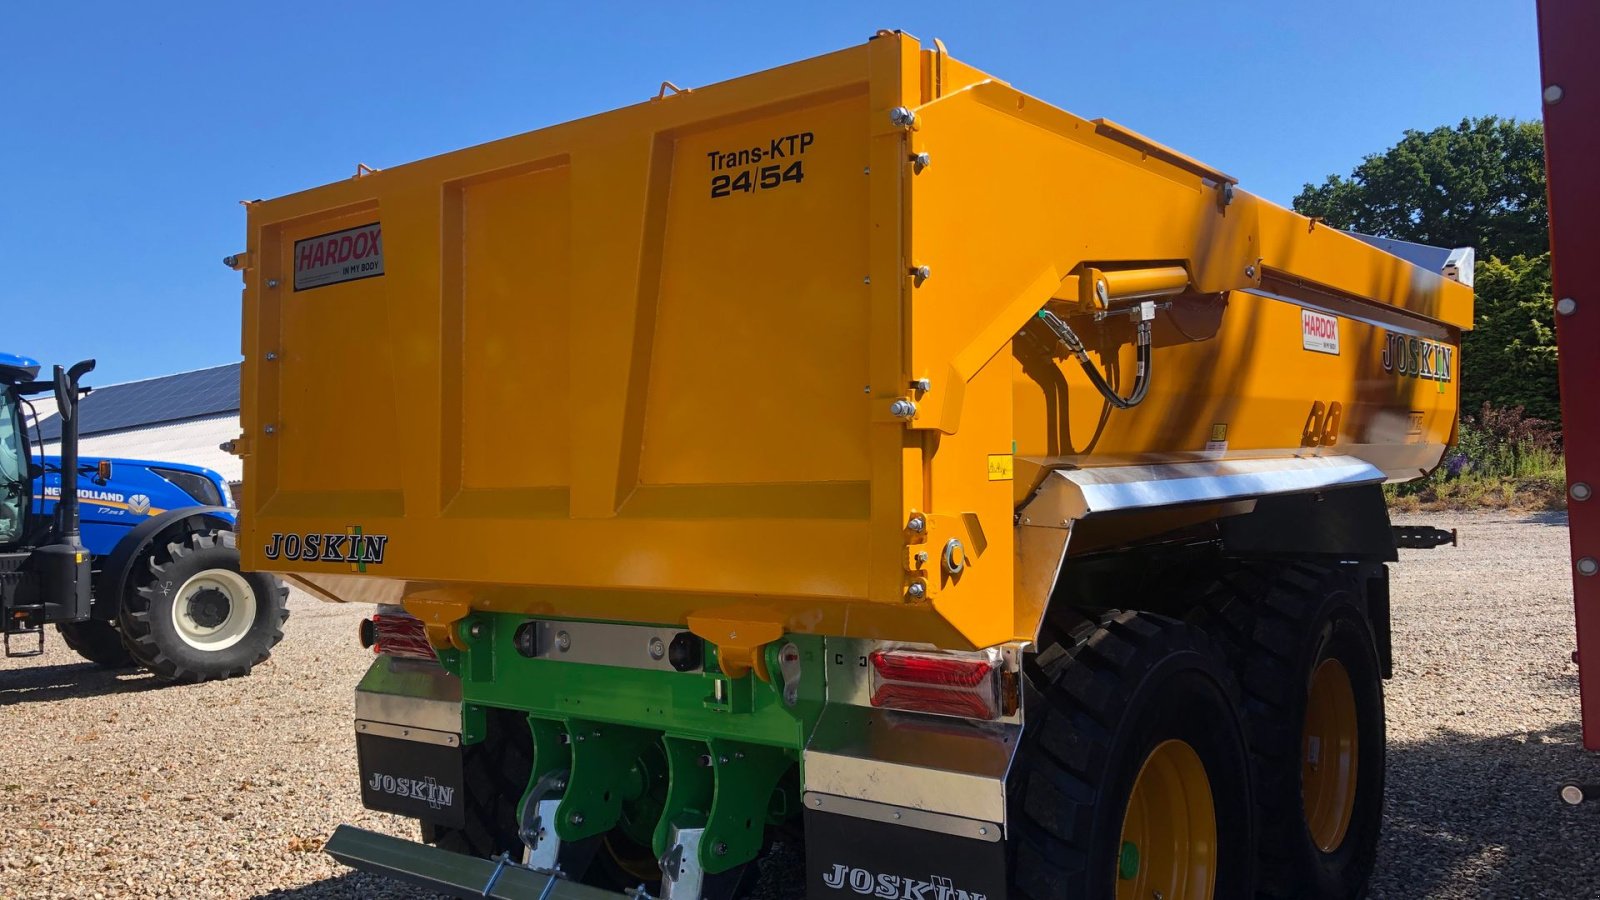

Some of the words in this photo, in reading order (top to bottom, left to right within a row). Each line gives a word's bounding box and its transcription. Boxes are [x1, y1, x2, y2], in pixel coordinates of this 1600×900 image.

[707, 132, 814, 171] Trans-KTP
[711, 160, 804, 199] 24/54
[299, 226, 381, 272] HARDOX
[342, 267, 350, 275] IN
[350, 264, 360, 274] MY
[361, 261, 379, 272] BODY
[1304, 313, 1336, 340] HARDOX
[1382, 332, 1452, 383] JOSKIN
[264, 532, 388, 564] JOSKIN
[369, 772, 455, 807] JOSKIN
